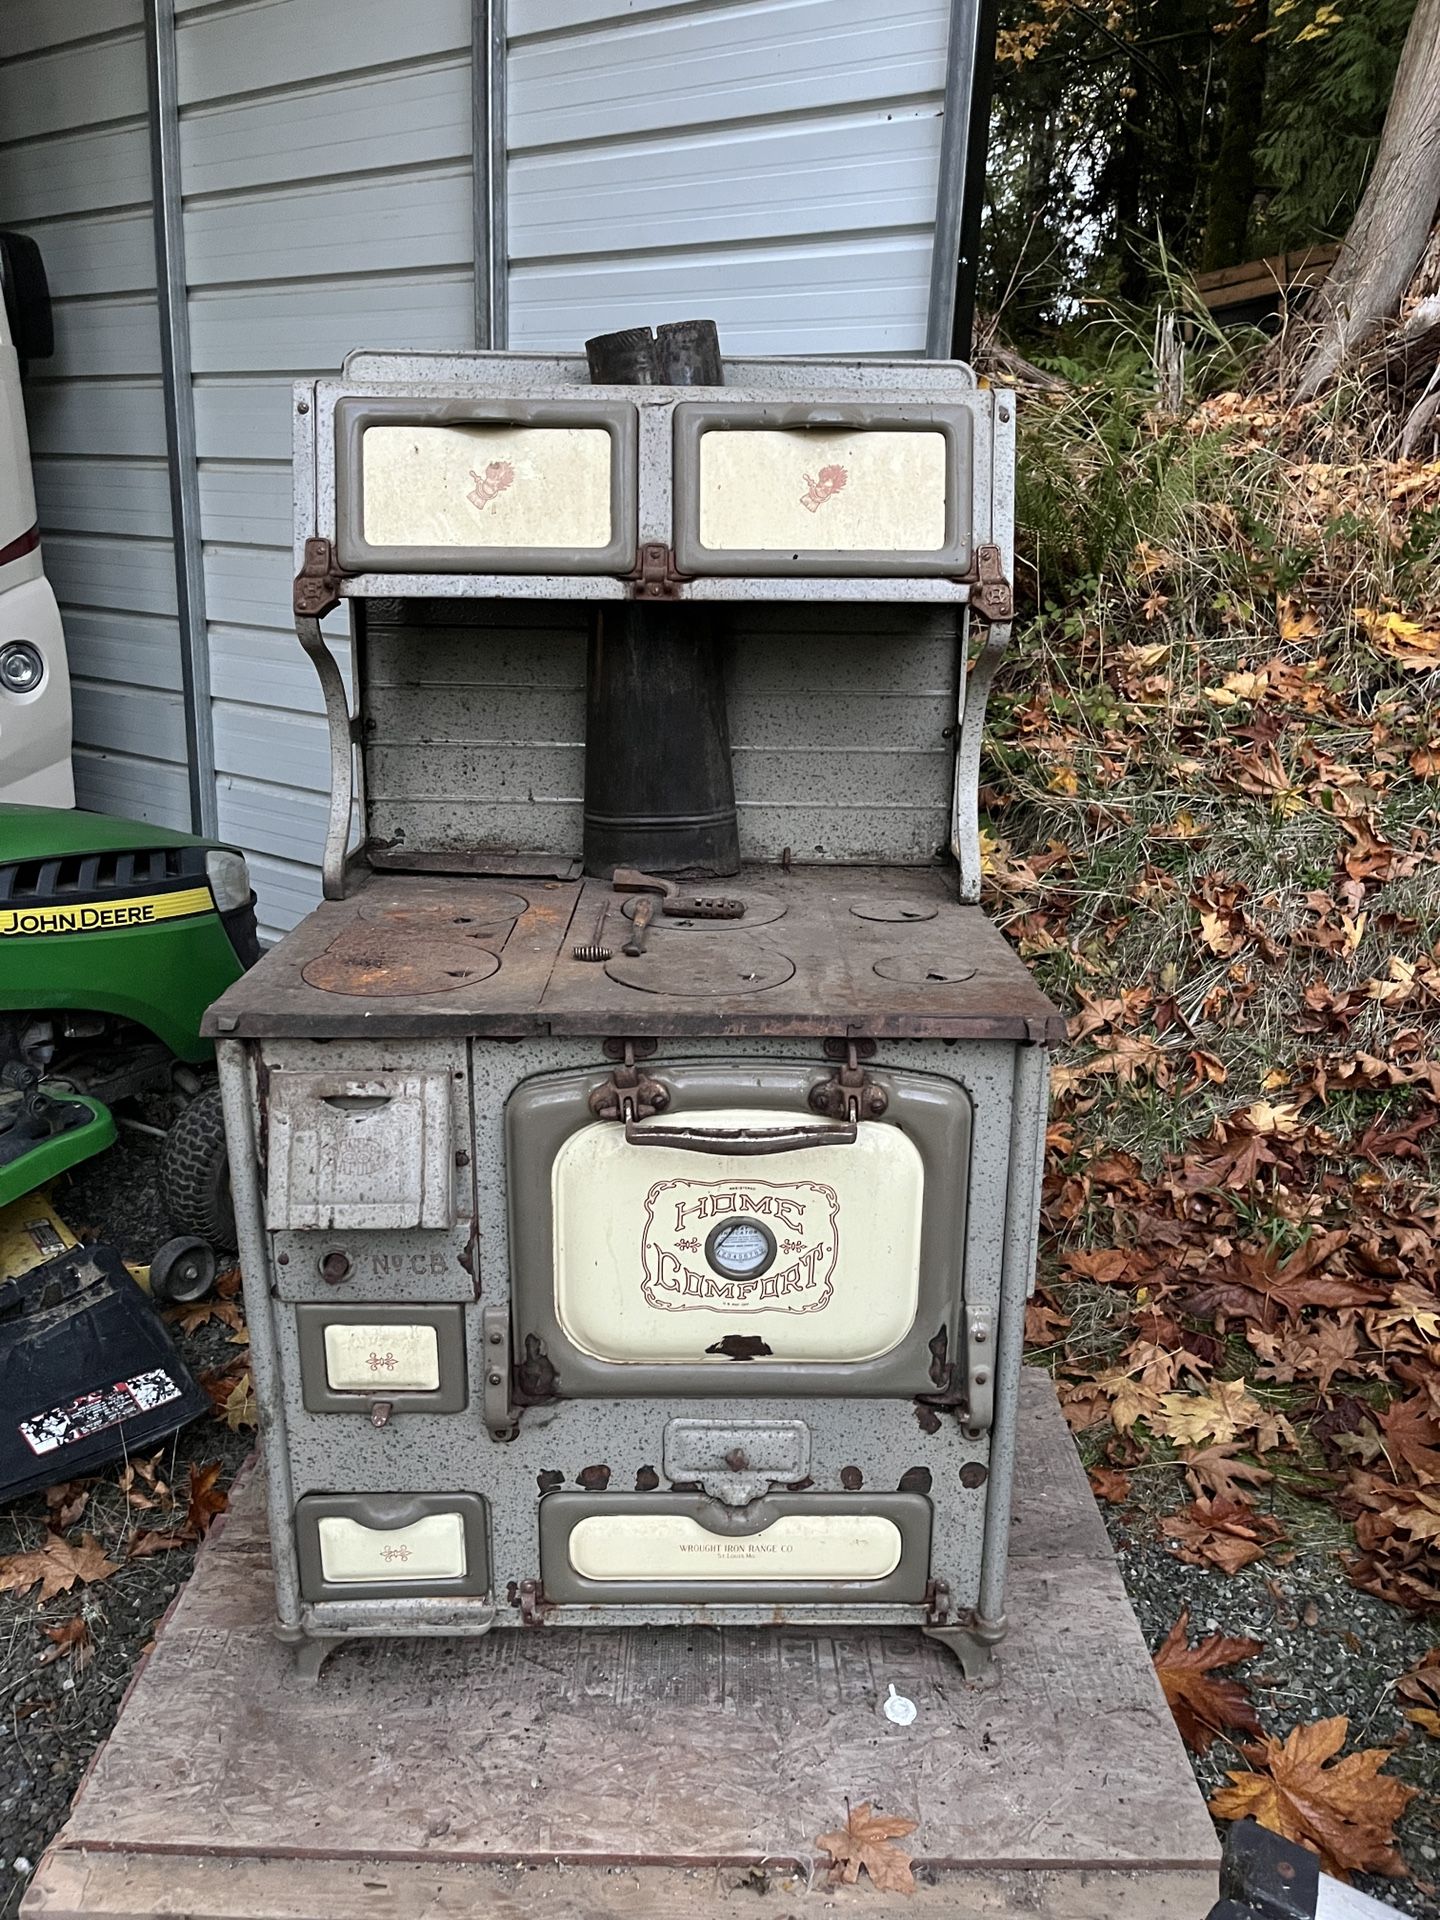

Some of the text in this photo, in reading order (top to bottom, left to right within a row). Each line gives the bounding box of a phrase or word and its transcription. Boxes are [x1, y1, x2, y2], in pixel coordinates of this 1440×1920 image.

[4, 905, 155, 933] JOHN DEERE
[675, 1192, 806, 1235] HOME
[653, 1242, 825, 1300] COMFORT
[679, 1544, 722, 1553] WROUGHT
[724, 1544, 745, 1553] IRON
[748, 1544, 777, 1553] RANGE
